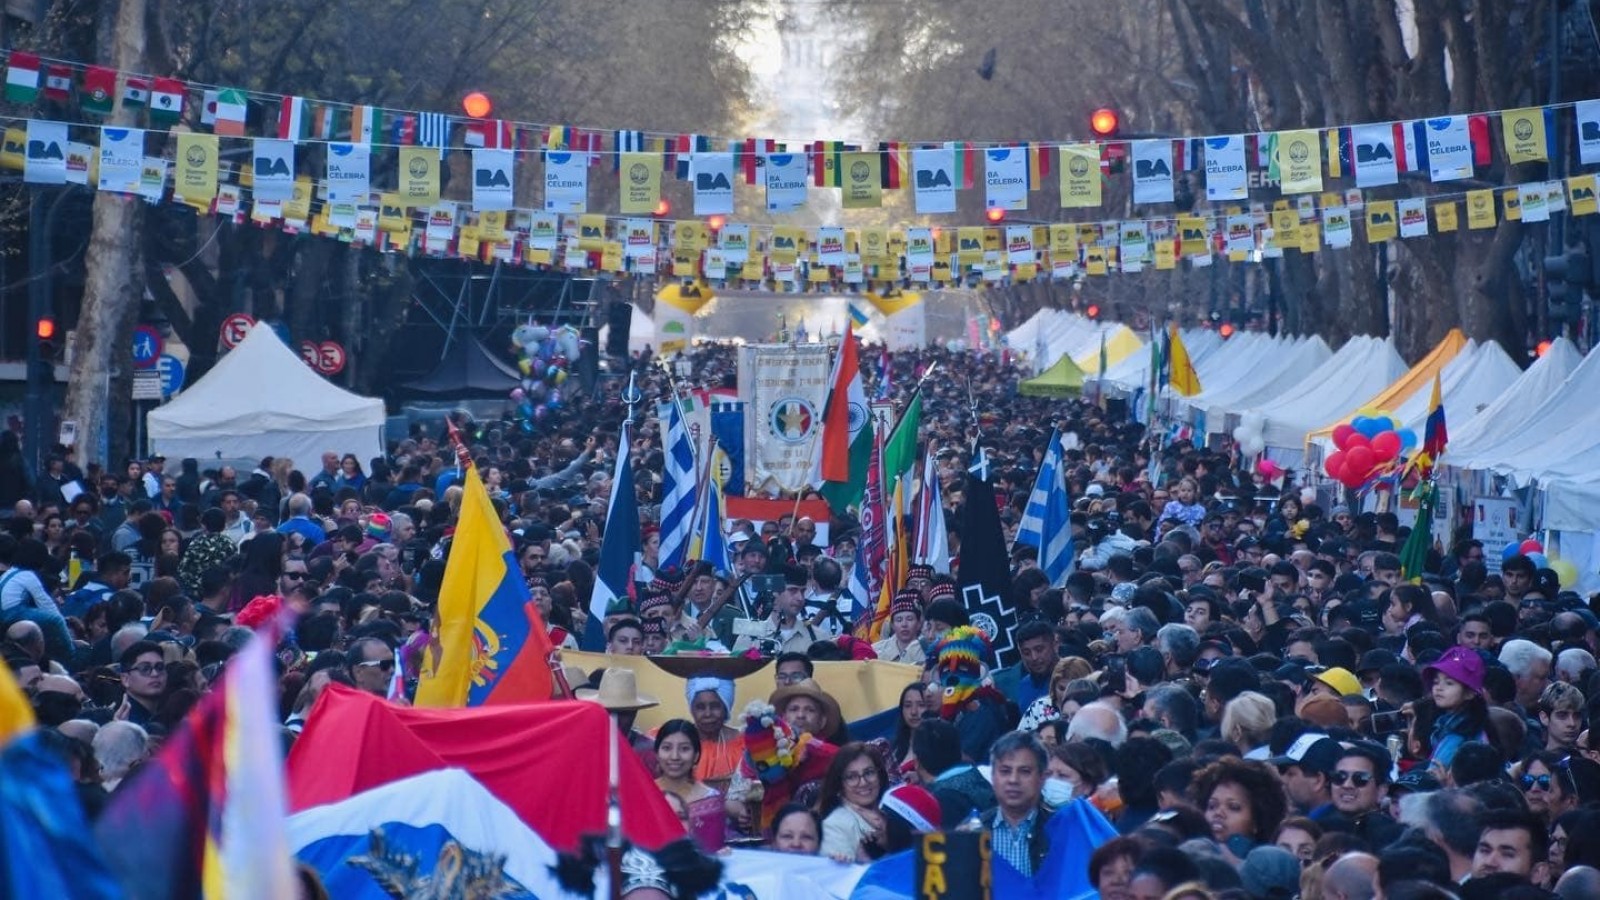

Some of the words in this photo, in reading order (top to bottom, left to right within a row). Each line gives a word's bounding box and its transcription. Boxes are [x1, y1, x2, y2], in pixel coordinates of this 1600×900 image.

[1582, 121, 1600, 141] B
[28, 140, 64, 161] BA
[1357, 142, 1392, 162] BA
[1430, 145, 1467, 155] CELEBRA
[70, 154, 84, 162] BA
[255, 156, 290, 176] BA
[1136, 159, 1170, 178] BA
[1208, 165, 1244, 173] CELEBRA
[144, 168, 159, 177] BA
[476, 169, 510, 187] BA
[917, 169, 951, 188] BA
[697, 172, 731, 191] BA
[1248, 171, 1281, 188] ER
[1572, 187, 1595, 200] BA
[383, 206, 402, 218] BA
[1407, 209, 1420, 217] BA
[1330, 216, 1344, 224] BA
[1371, 213, 1393, 224] BA
[537, 221, 550, 229] BA
[582, 226, 602, 238] BA
[1183, 229, 1204, 239] BA
[775, 237, 795, 248] BA
[960, 238, 981, 250] BA
[923, 833, 946, 900] CA
